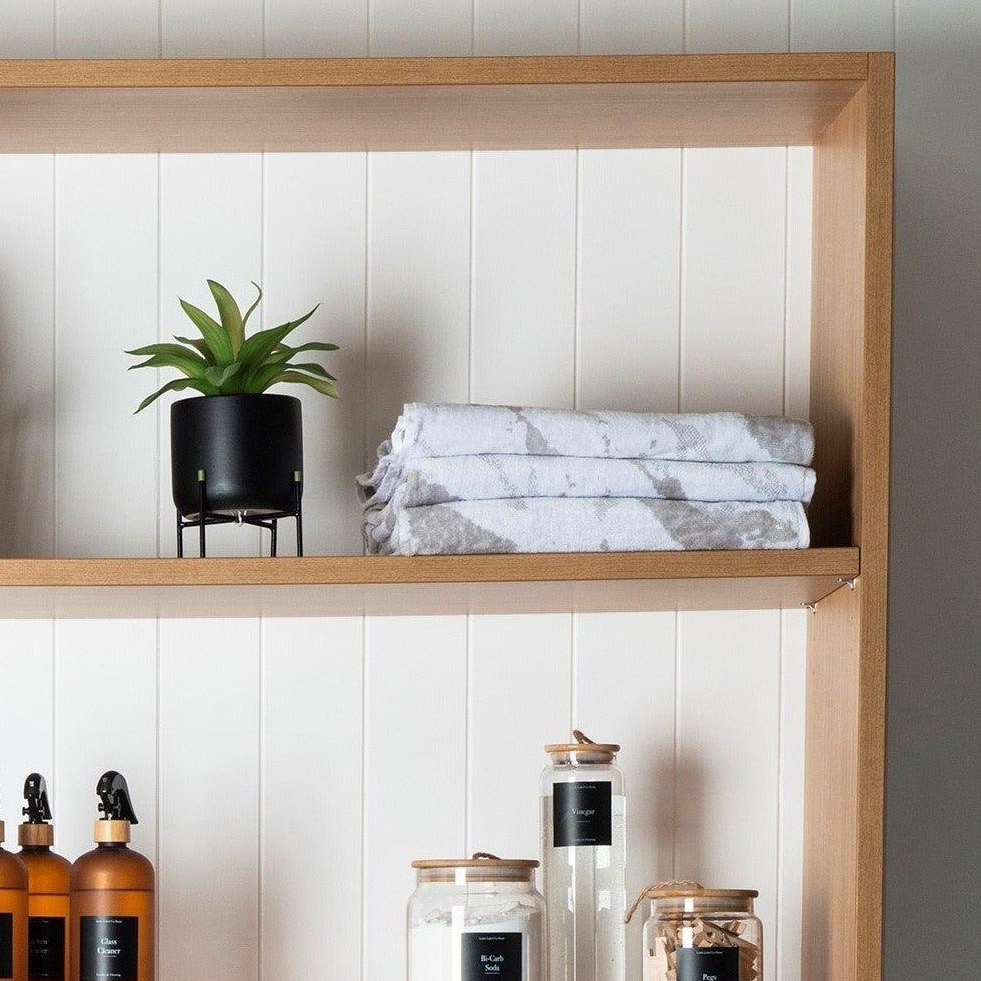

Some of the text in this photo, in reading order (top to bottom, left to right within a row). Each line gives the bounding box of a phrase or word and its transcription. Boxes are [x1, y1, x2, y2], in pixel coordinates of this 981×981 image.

[100, 937, 117, 945] Glass
[480, 954, 505, 962] Bi-Carb
[484, 964, 500, 972] Soda
